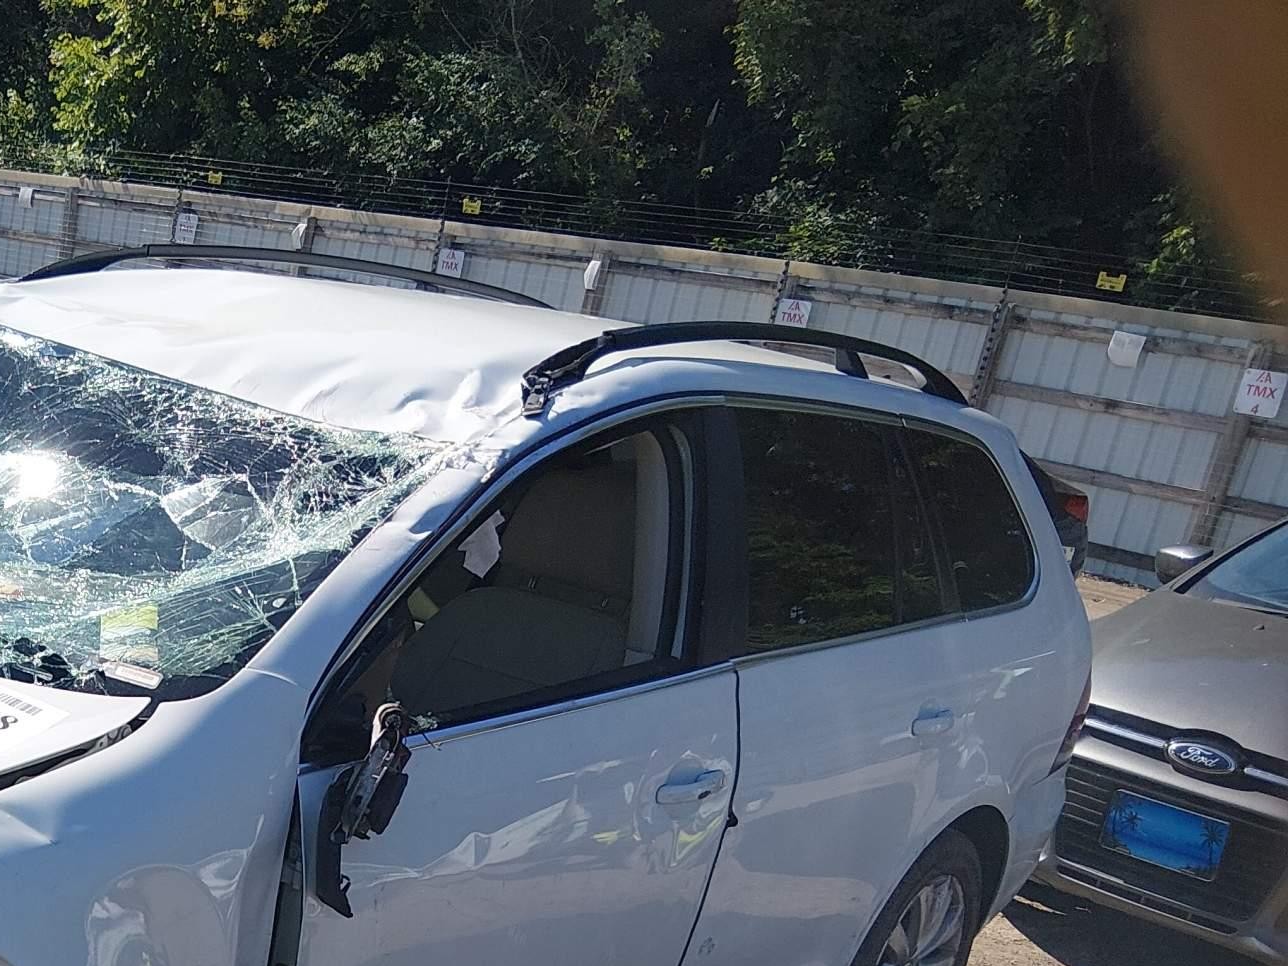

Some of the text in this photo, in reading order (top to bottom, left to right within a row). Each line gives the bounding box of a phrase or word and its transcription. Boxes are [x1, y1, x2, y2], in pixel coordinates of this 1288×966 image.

[441, 260, 459, 272] TMX
[781, 311, 804, 325] TMX
[1246, 384, 1277, 400] TMX
[1250, 403, 1260, 415] 4
[1179, 746, 1220, 768] Ford
